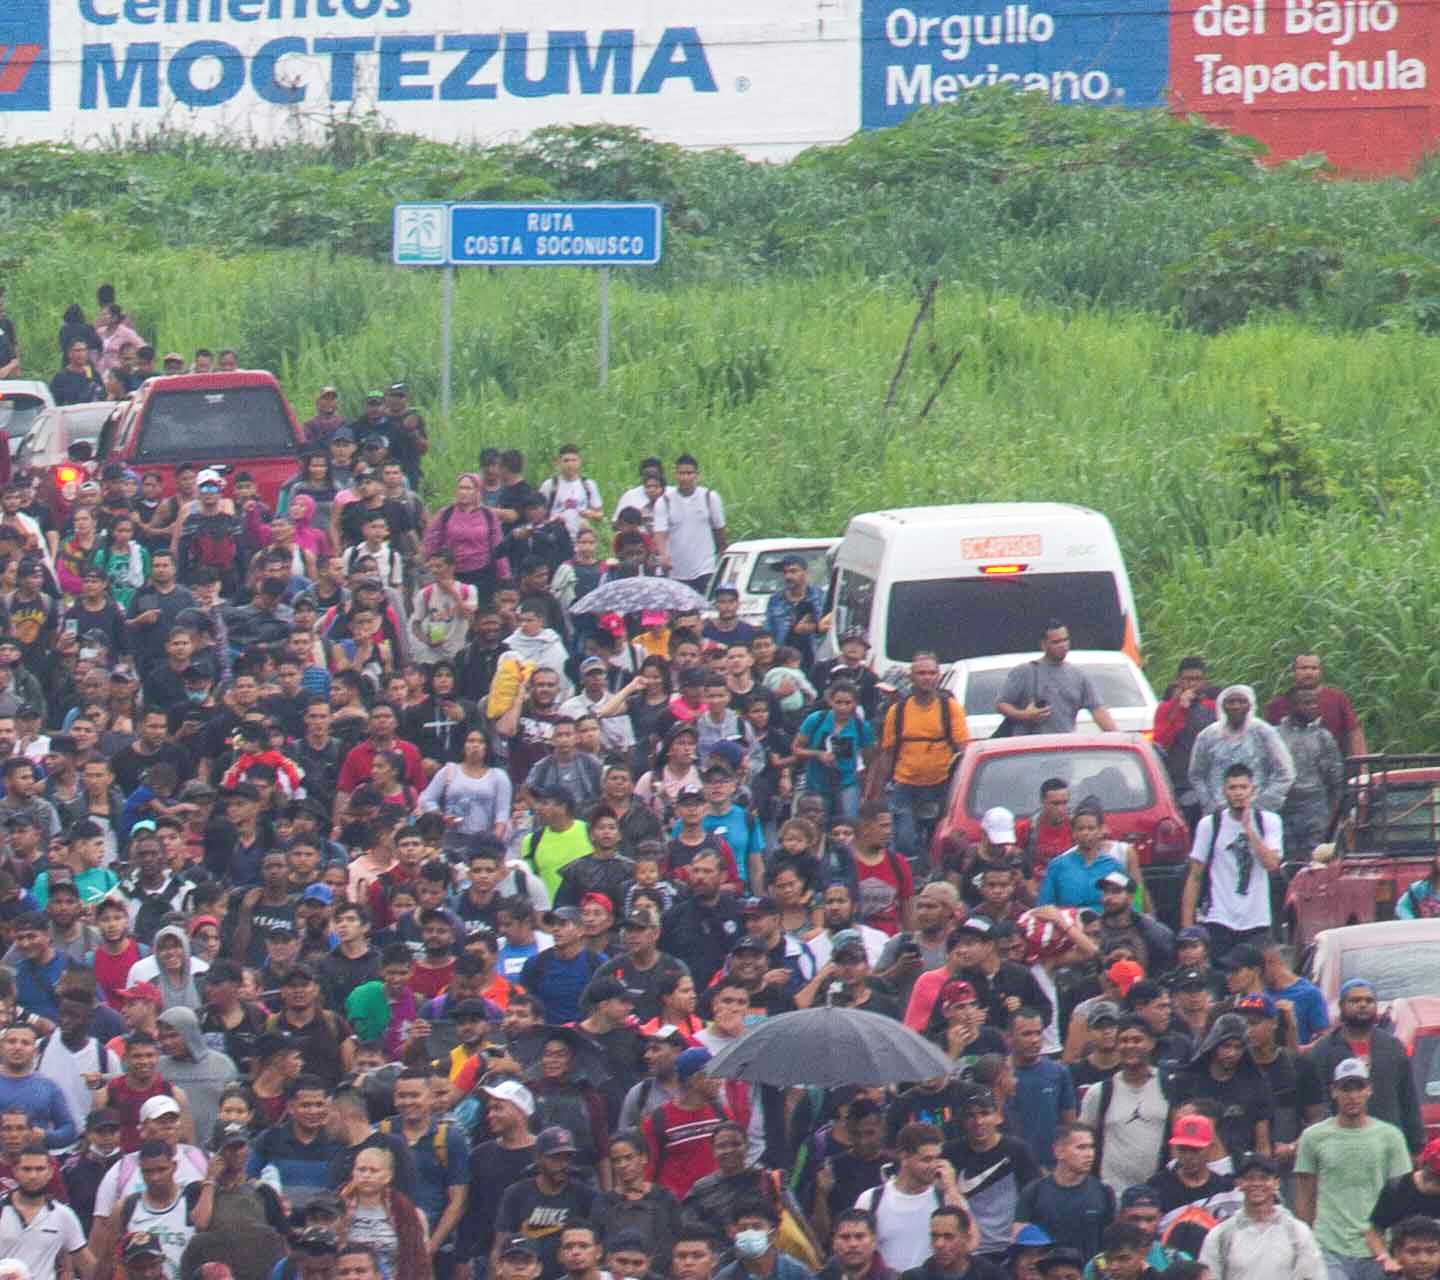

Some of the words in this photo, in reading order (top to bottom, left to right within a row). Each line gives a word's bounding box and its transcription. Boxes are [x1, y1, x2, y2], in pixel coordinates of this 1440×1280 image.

[885, 6, 1054, 59] Orgullo
[1192, 0, 1268, 37] del
[79, 27, 719, 109] MOCTEZUMA
[1193, 51, 1428, 96] Tapachula
[528, 213, 574, 232] RUTA
[464, 236, 523, 255] COSTA
[537, 236, 644, 254] SOCONUSCO
[528, 1206, 570, 1226] NIKE
